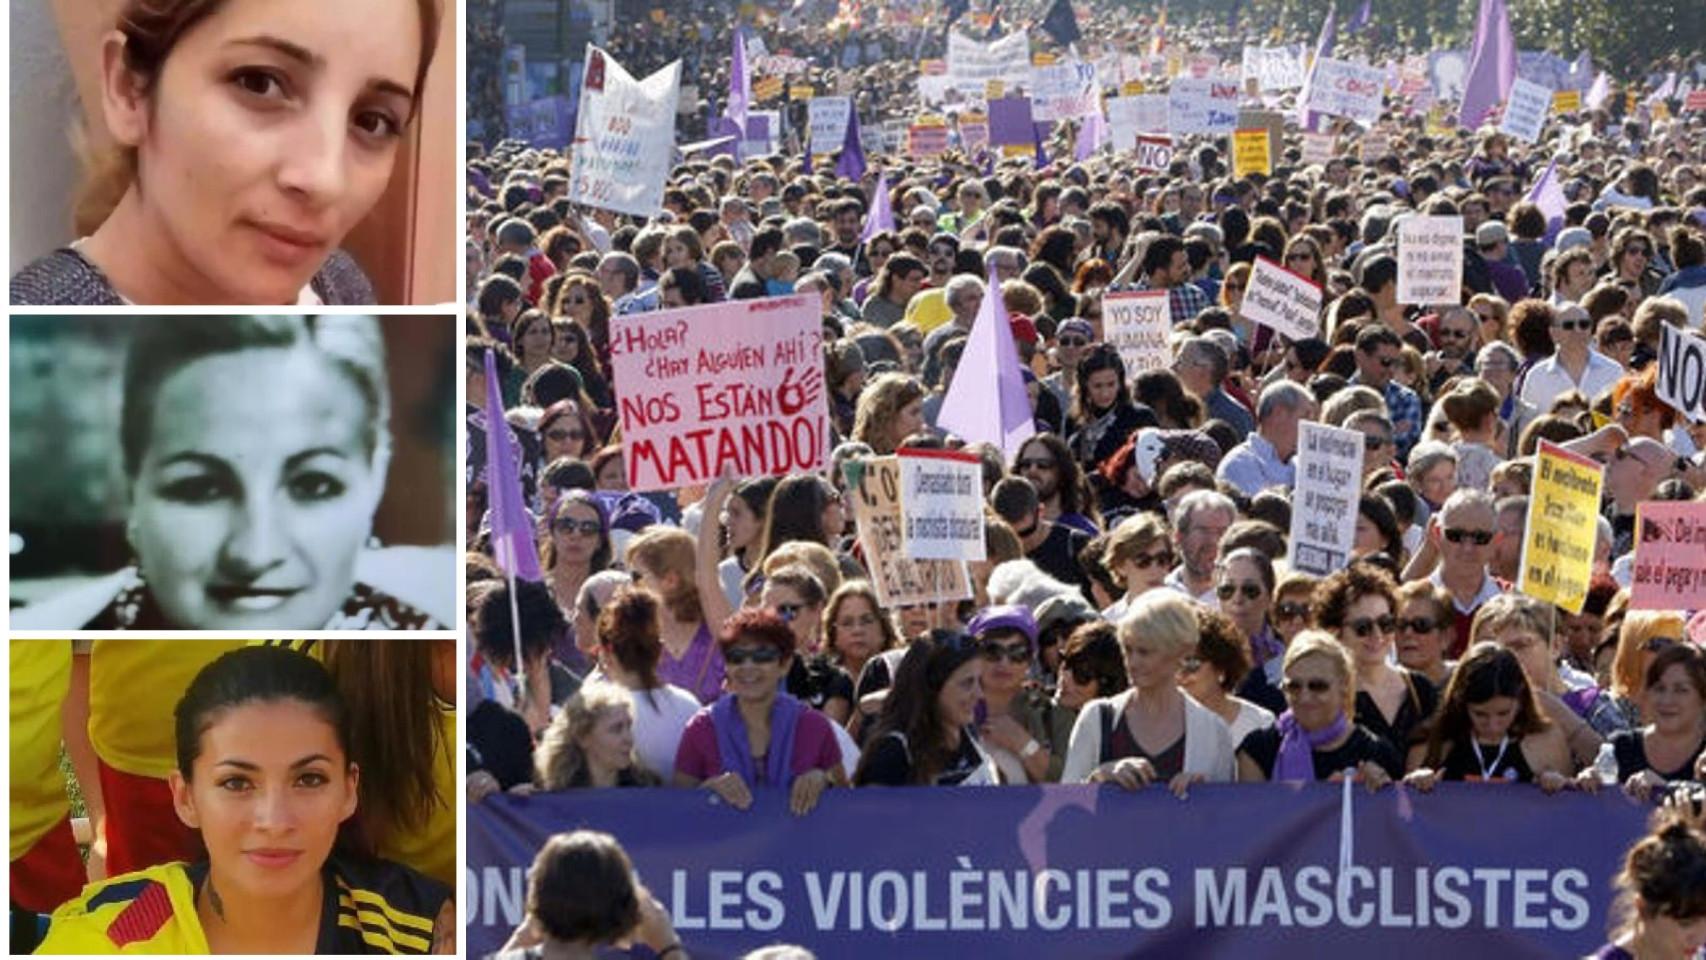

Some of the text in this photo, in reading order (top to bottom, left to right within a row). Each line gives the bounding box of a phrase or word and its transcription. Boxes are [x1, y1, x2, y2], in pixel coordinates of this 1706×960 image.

[1138, 144, 1170, 170] NO
[1111, 304, 1163, 325] YO SOY
[622, 392, 681, 432] NOS
[630, 415, 824, 488] MATANDO!
[672, 870, 786, 930] LES
[805, 856, 1172, 930] VIOLÈNCIES
[1195, 866, 1591, 930] MASCLISTES
